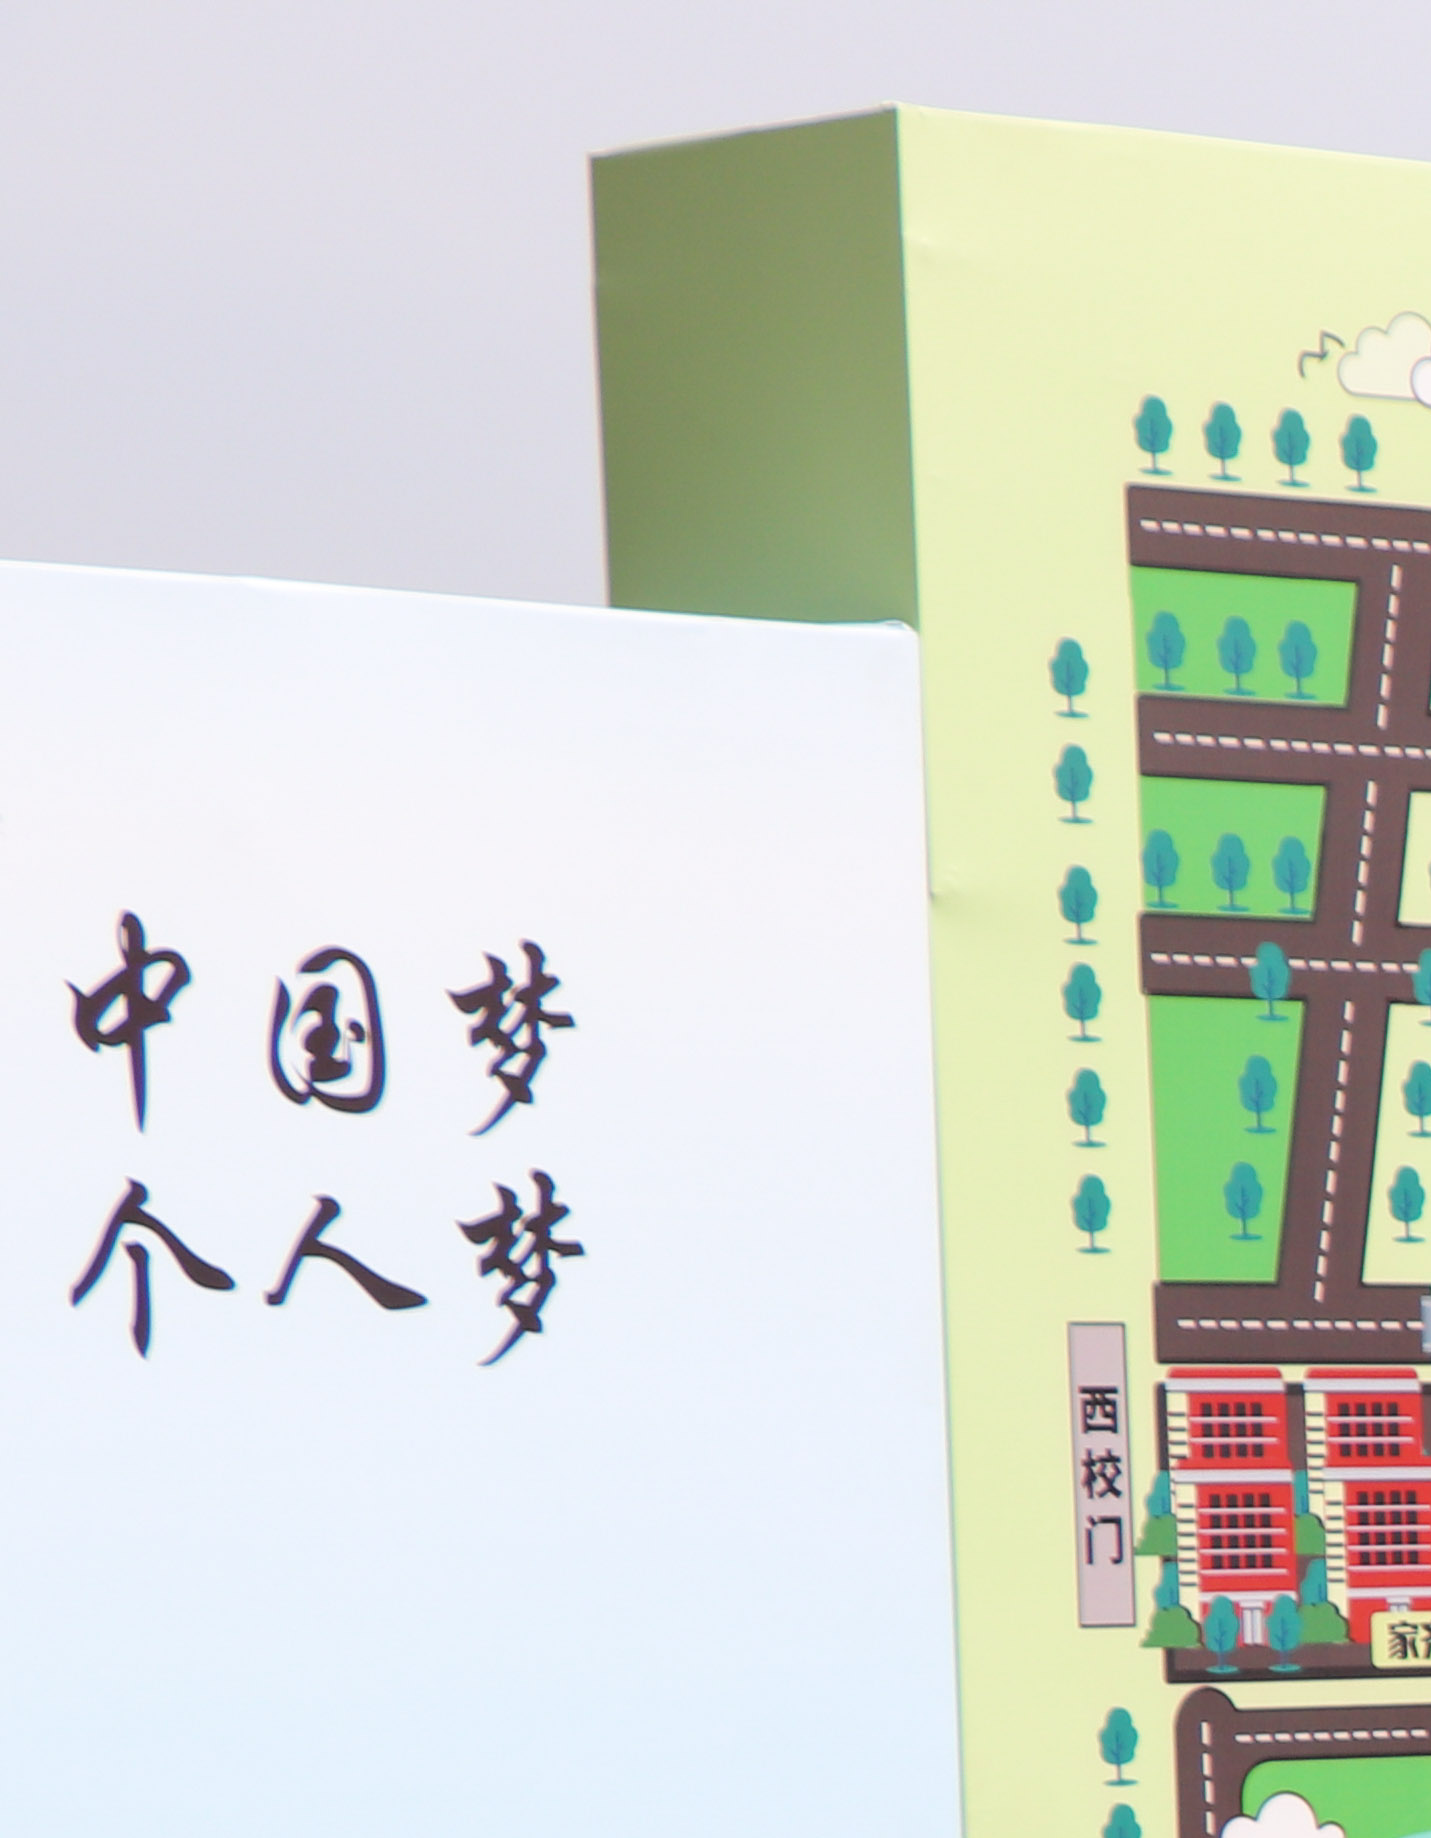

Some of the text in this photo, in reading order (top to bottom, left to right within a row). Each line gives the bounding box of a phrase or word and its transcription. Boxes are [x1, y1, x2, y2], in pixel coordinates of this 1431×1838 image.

[64, 908, 577, 1136] 中国梦
[67, 1167, 587, 1368] 个人梦
[1078, 1385, 1125, 1566] 西校门
